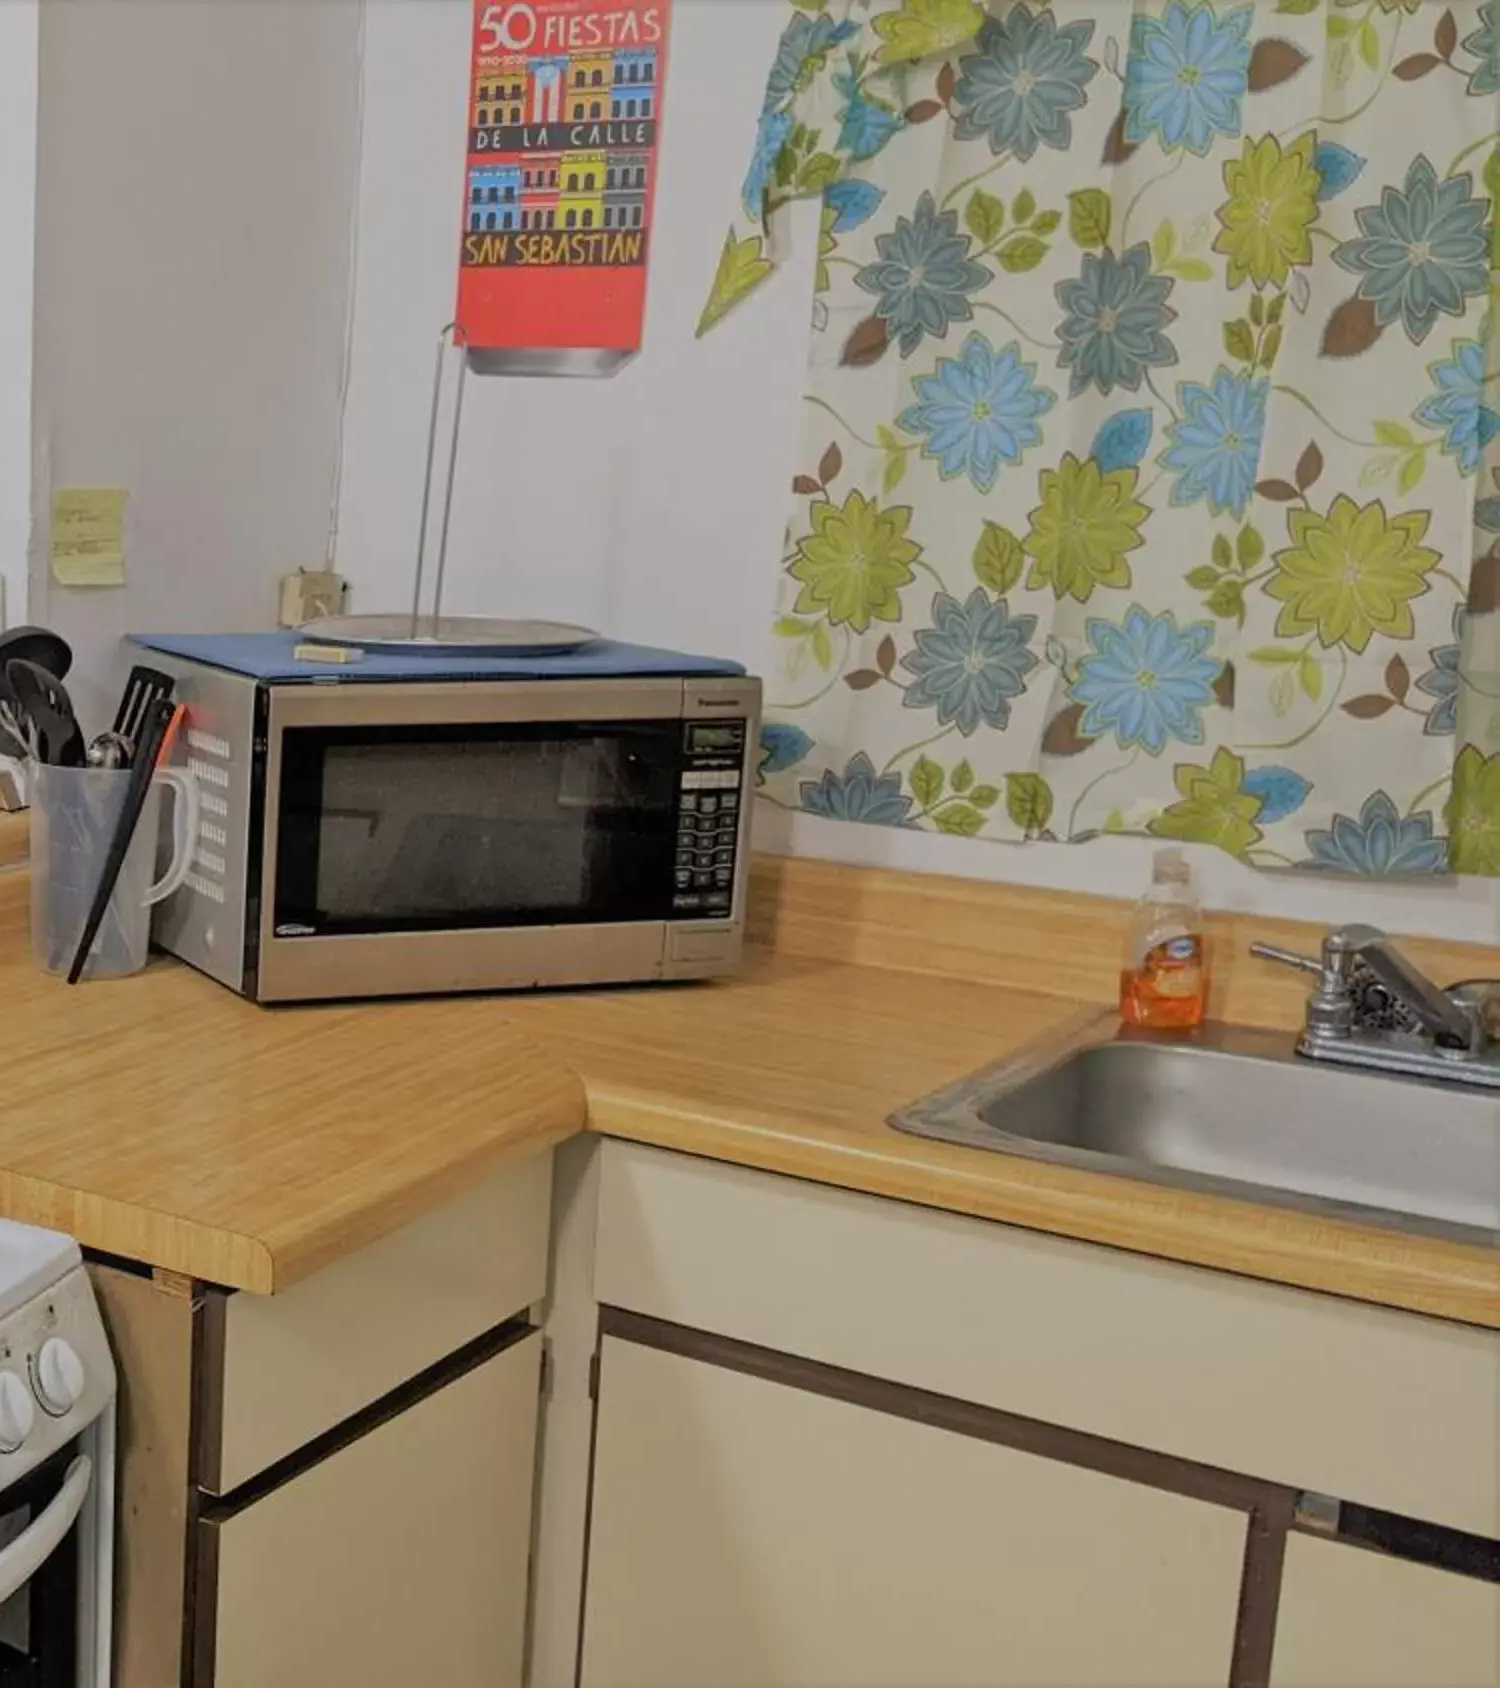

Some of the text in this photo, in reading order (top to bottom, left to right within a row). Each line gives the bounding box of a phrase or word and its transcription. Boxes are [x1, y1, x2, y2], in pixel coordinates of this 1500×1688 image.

[480, 3, 661, 52] 50 FIESTAS
[476, 123, 646, 149] DE LA CALLE
[465, 228, 642, 265] SAN SEBASTIÁN
